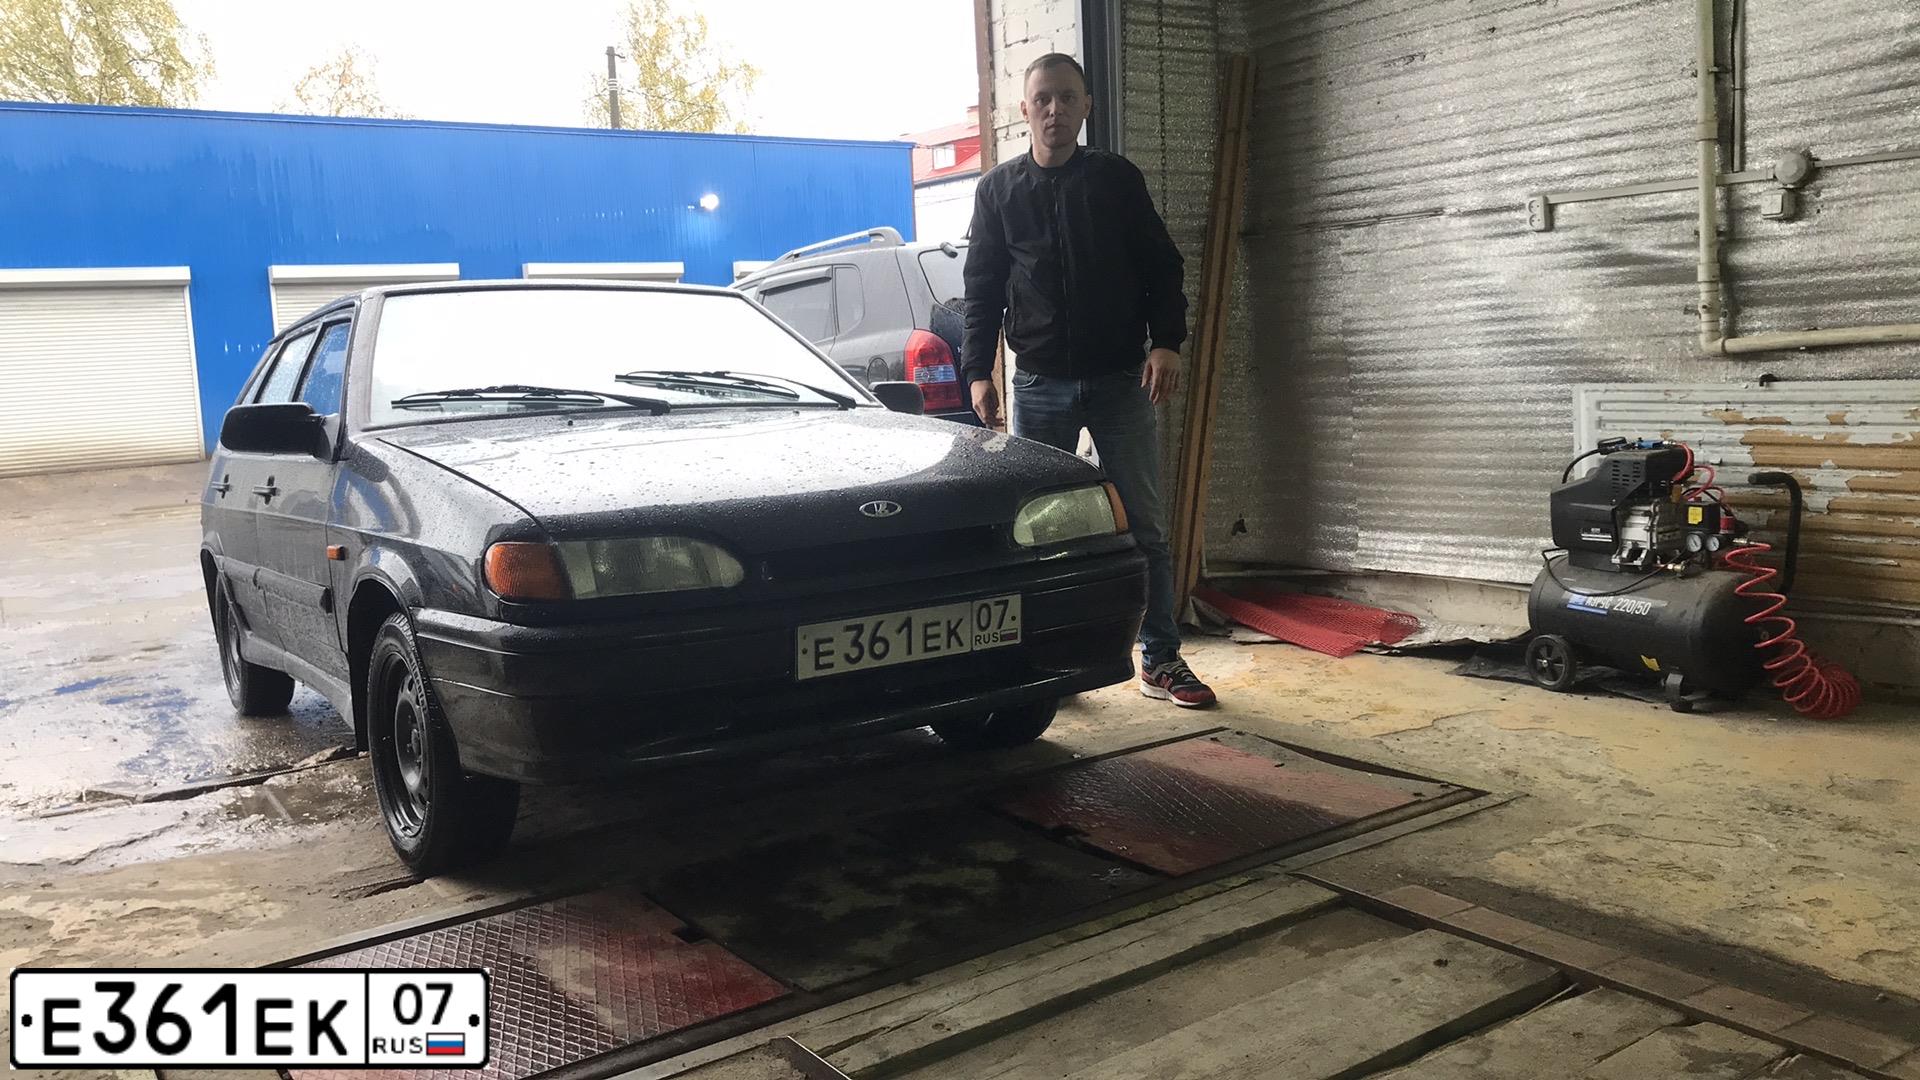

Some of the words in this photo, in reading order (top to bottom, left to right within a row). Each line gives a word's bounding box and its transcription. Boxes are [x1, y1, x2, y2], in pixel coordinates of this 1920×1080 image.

[976, 599, 1009, 632] 07
[1613, 597, 1652, 616] 220/50
[974, 632, 999, 646] RUS
